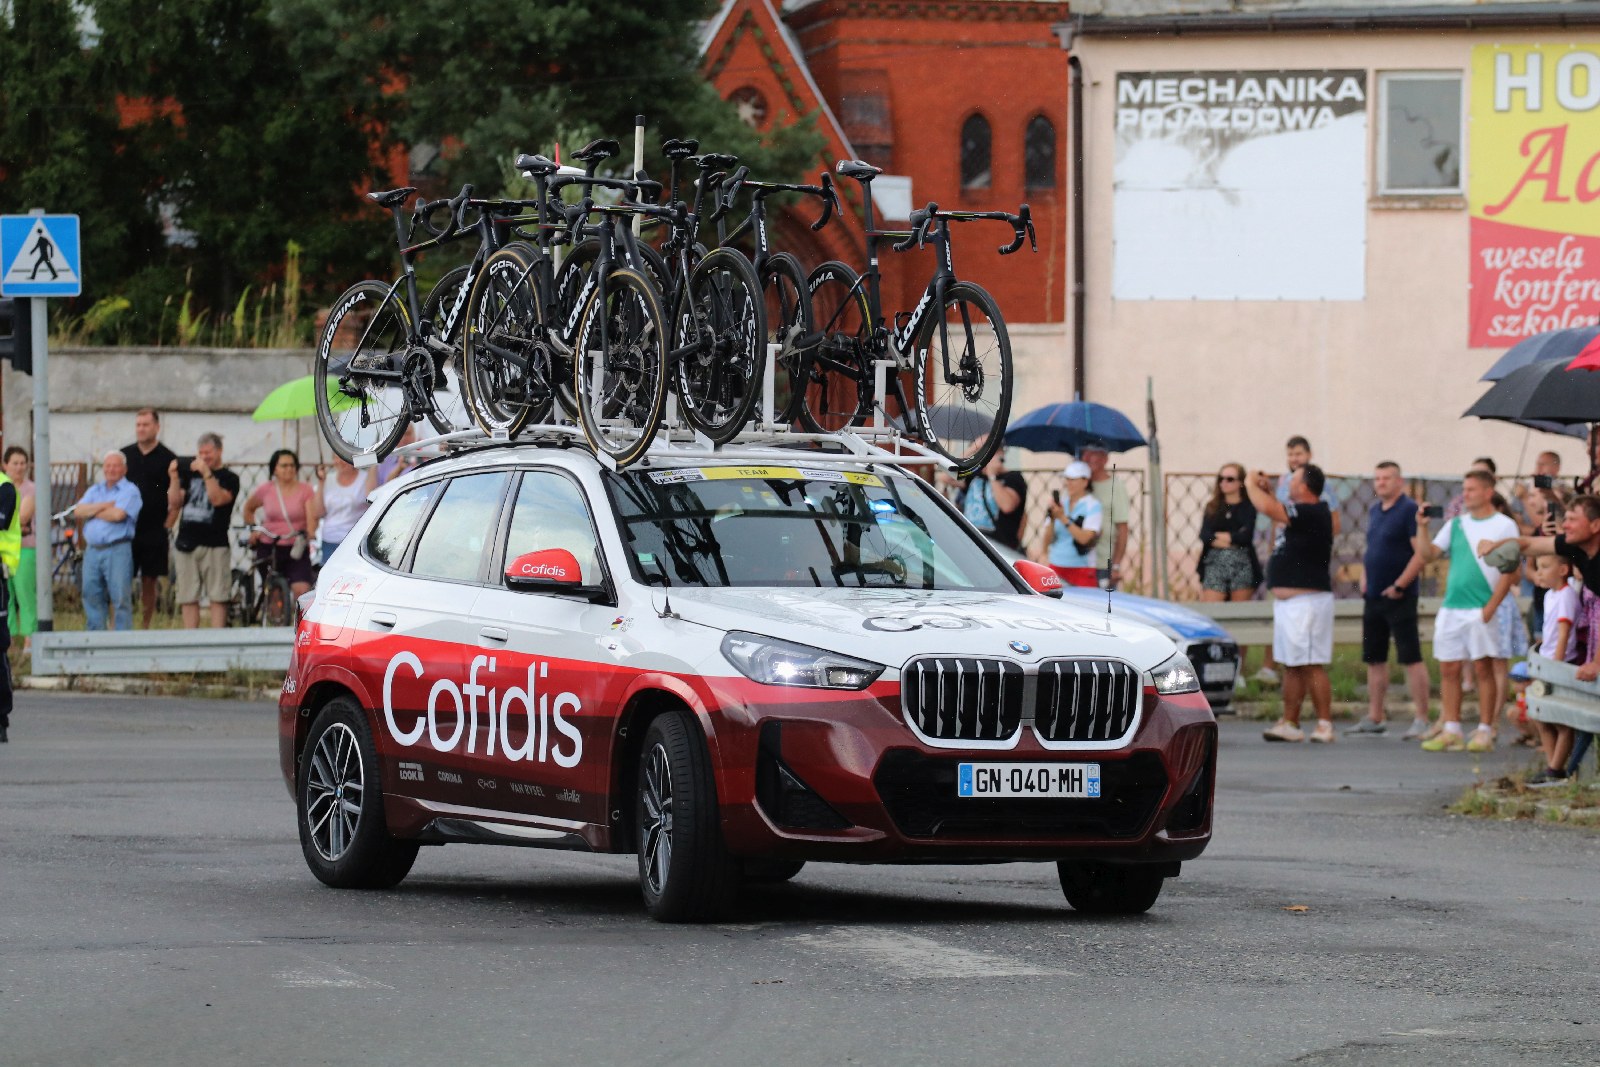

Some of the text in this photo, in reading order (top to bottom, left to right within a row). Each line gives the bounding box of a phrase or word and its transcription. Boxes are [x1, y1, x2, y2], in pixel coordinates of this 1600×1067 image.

[1118, 77, 1365, 104] MECHANIKA
[1480, 236, 1584, 269] wesela
[321, 291, 367, 360] CORIMA
[441, 268, 475, 342] LOOK
[898, 288, 931, 351] LOOK
[917, 348, 937, 443] CORIMA
[521, 563, 566, 577] Cofidis
[382, 651, 583, 768] Cofidis
[976, 768, 1083, 793] GN-040-MH
[1088, 781, 1099, 793] 59
